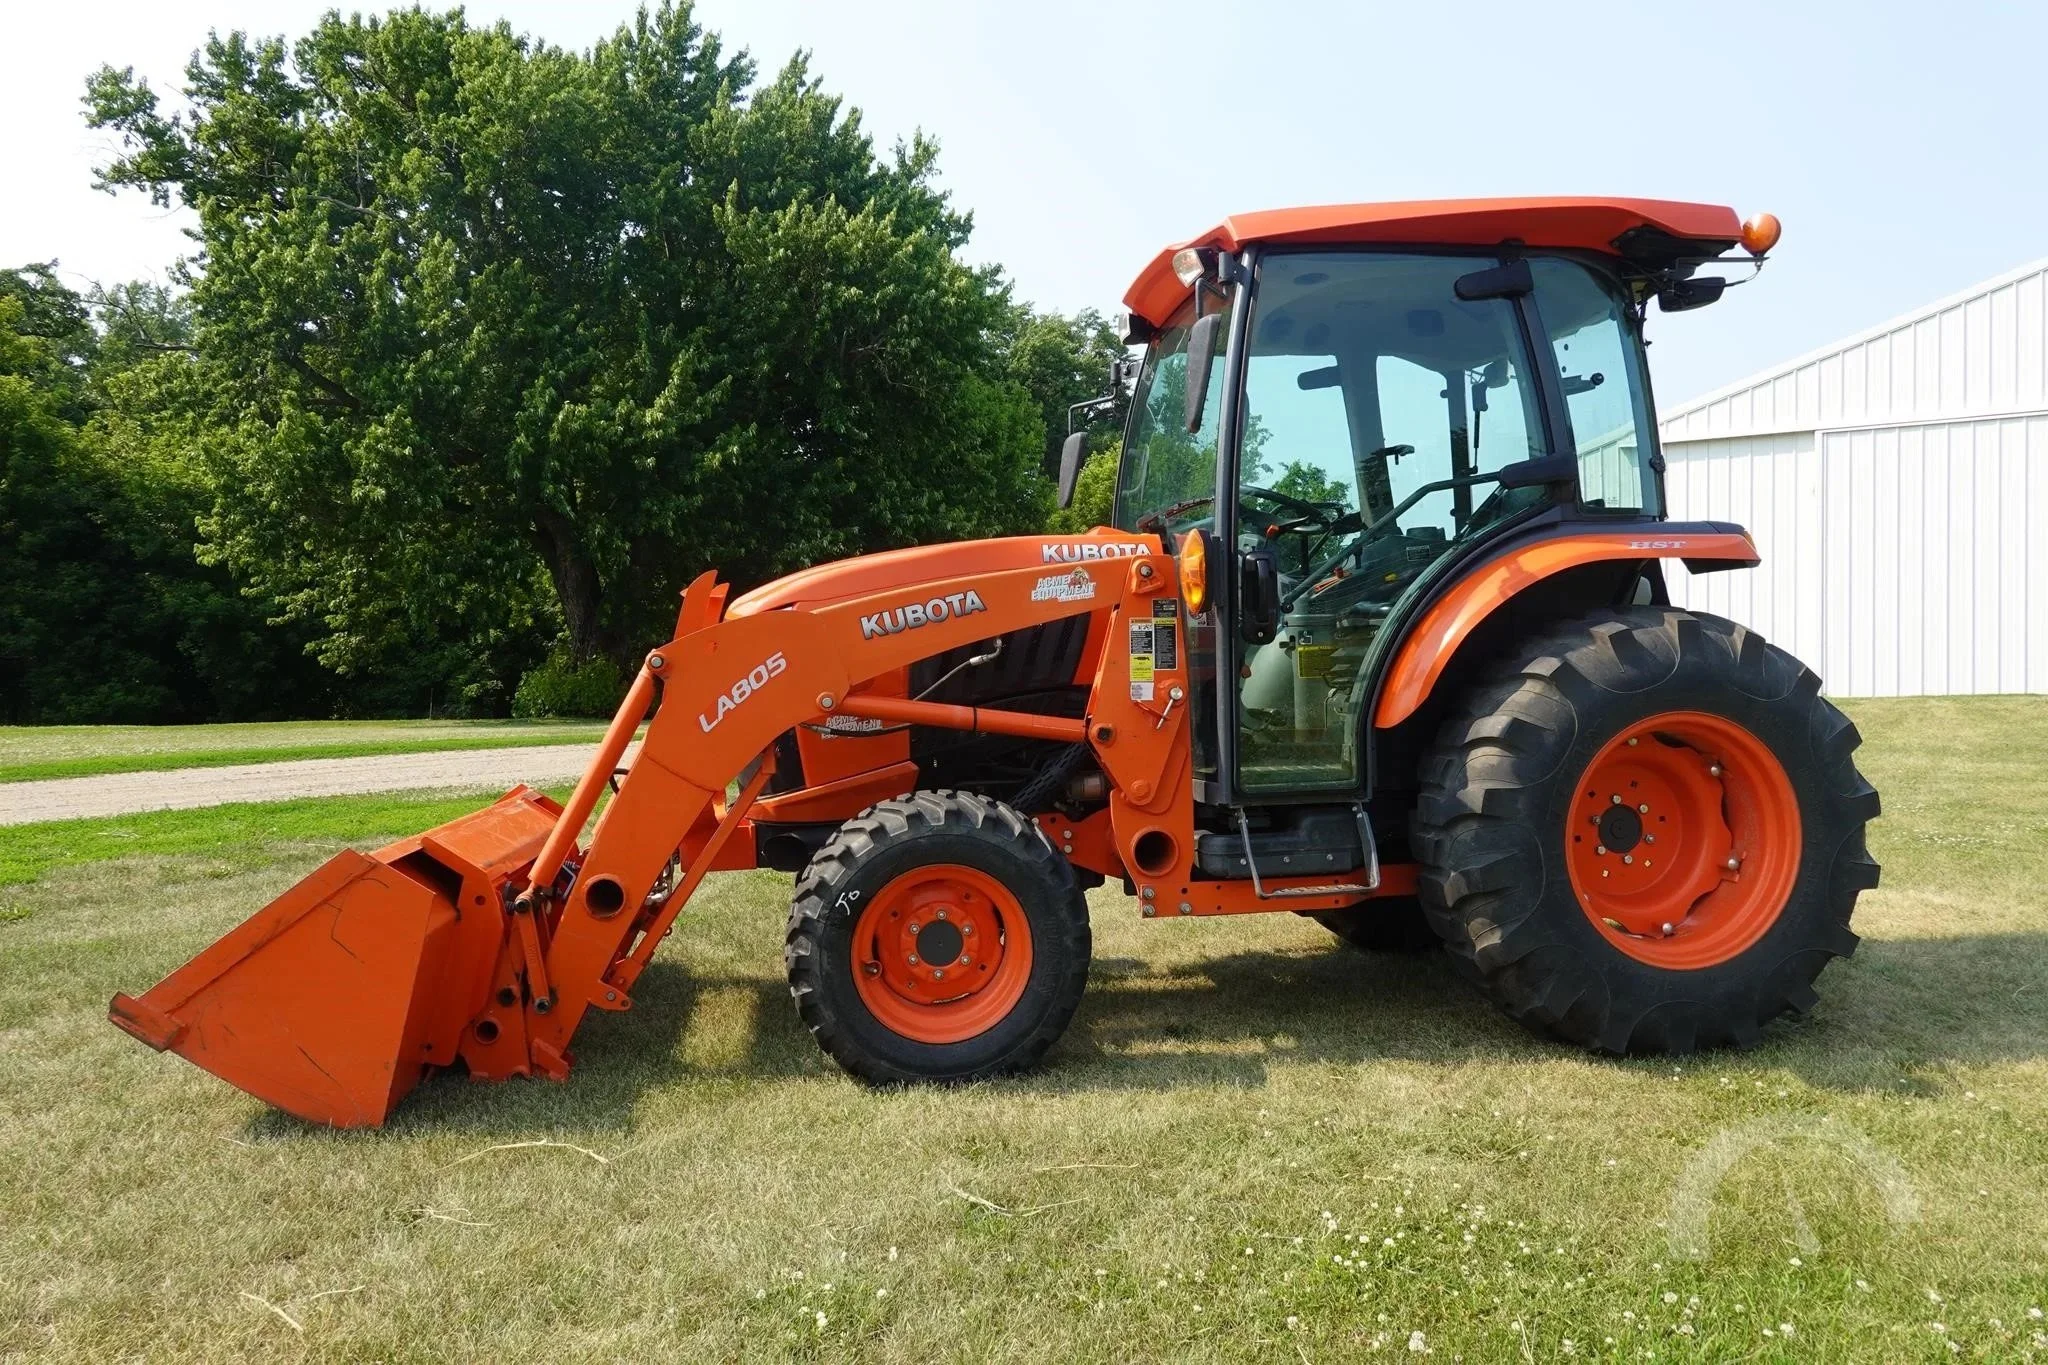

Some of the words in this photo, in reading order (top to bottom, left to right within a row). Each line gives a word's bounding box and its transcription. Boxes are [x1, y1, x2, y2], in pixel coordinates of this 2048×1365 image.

[1042, 543, 1152, 562] KUBOTA
[1630, 540, 1686, 549] HST
[1032, 582, 1096, 601] EQUIPMENT
[1037, 575, 1070, 590] ACME
[860, 589, 987, 640] KUBOTA
[699, 651, 787, 733] LA805
